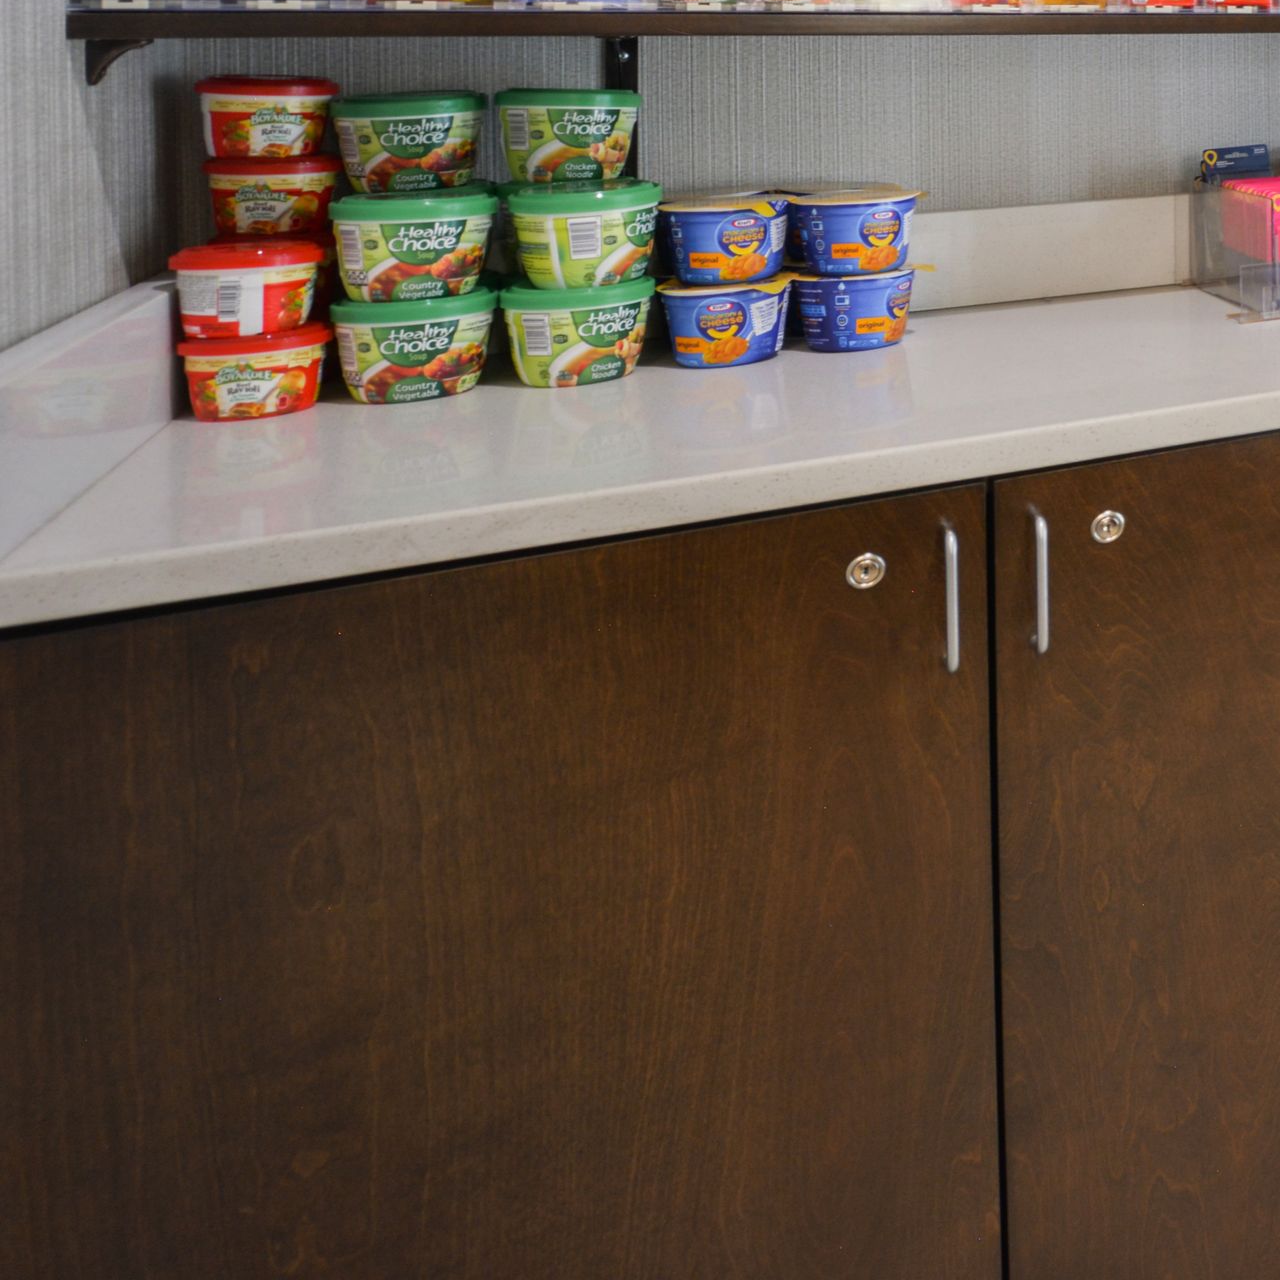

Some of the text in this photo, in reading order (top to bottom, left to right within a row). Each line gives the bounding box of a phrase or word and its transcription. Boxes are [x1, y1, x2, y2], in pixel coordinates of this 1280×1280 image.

[562, 108, 619, 127] Healthy
[388, 118, 450, 137] Healthy
[553, 121, 612, 137] Choice
[380, 130, 445, 146] Choice
[564, 163, 597, 172] Chicken
[399, 221, 463, 242] Healthy
[389, 235, 458, 252] Choice
[833, 245, 860, 256] original
[691, 255, 720, 266] original
[401, 280, 443, 292] Country
[589, 305, 640, 326] Healthy
[578, 317, 635, 338] Choice
[858, 319, 885, 331] original
[389, 323, 455, 344] Healthy
[380, 337, 450, 354] Choice
[590, 361, 622, 371] Chicken
[395, 383, 438, 395] Country
